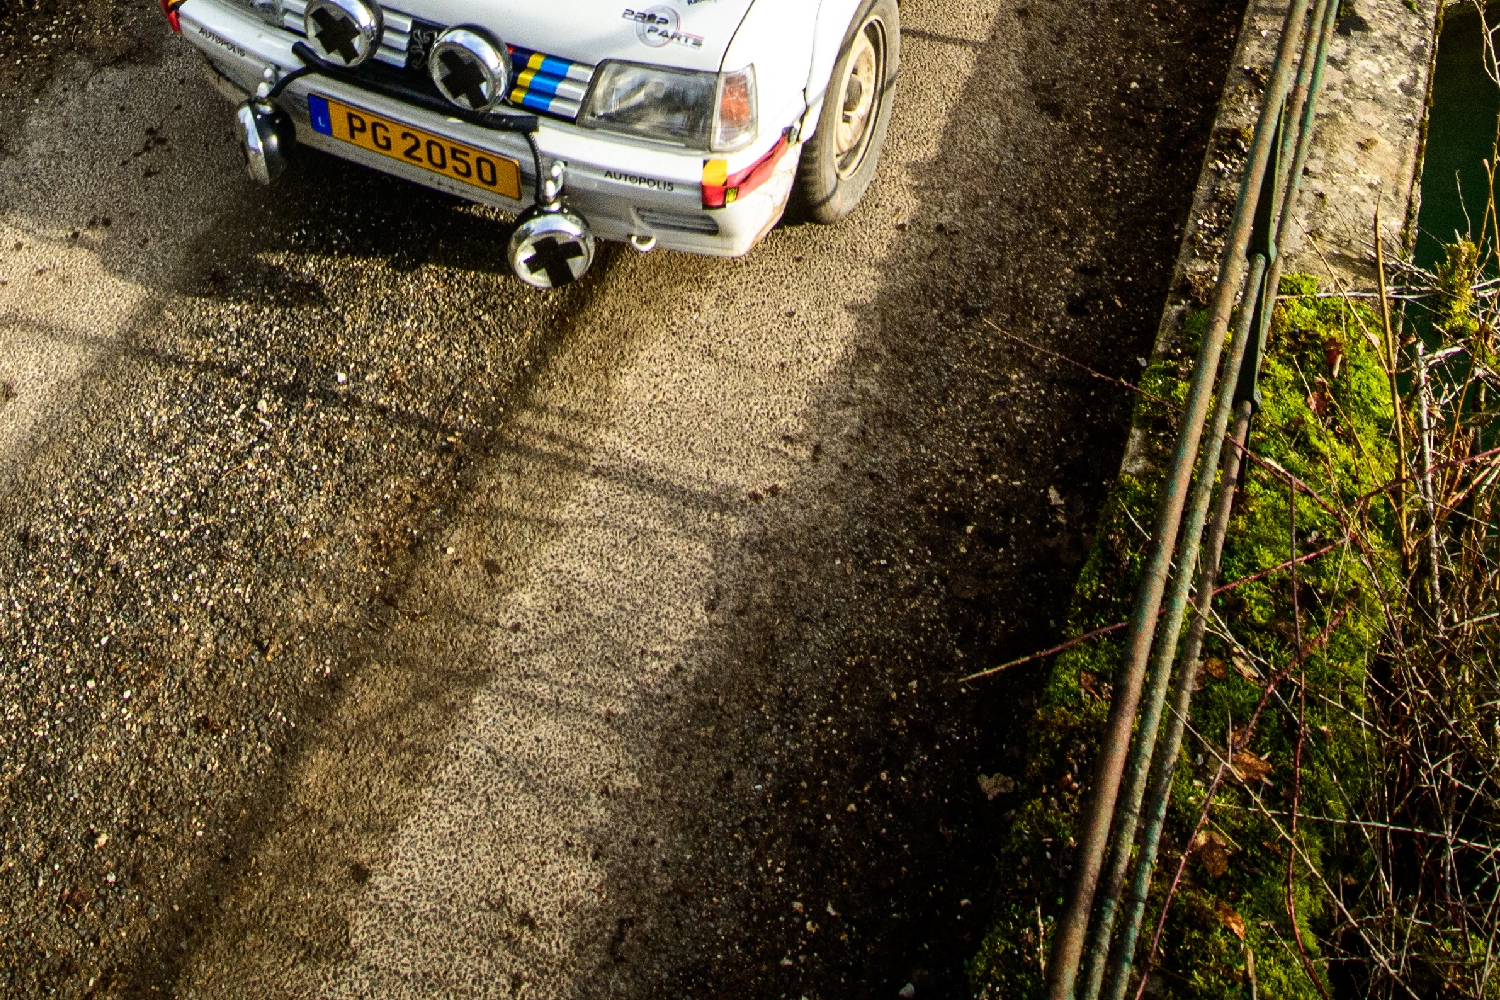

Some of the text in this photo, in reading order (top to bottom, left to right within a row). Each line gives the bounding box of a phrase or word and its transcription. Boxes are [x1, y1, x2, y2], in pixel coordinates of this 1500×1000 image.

[317, 111, 498, 187] L PG 2050
[604, 170, 674, 192] AUTOPOLIS
